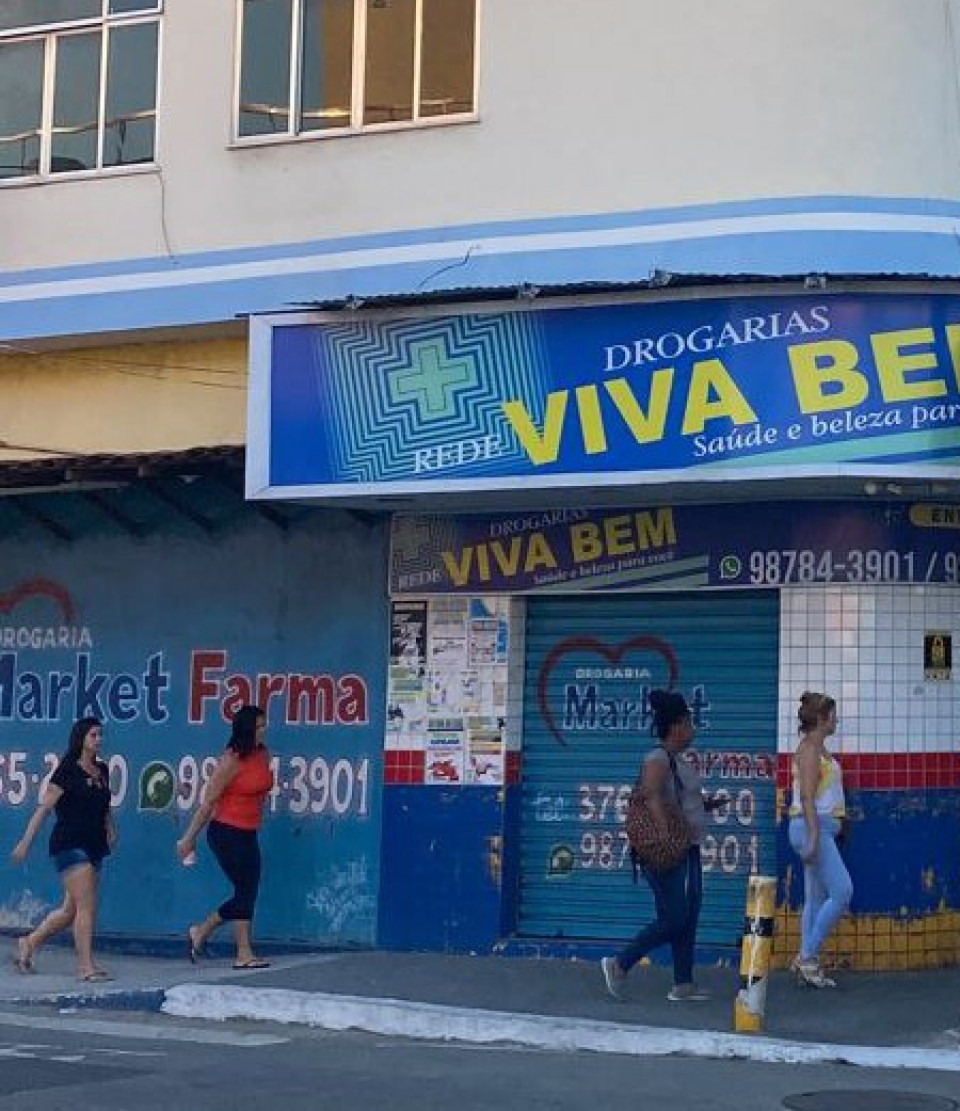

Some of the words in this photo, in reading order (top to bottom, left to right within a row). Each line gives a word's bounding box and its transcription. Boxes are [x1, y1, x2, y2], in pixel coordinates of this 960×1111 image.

[604, 306, 830, 371] DROGARIAS
[503, 359, 758, 465] VIVA
[692, 423, 777, 457] Saúde
[786, 423, 802, 441] e
[811, 408, 901, 437] beleza
[414, 436, 501, 474] REDE
[441, 532, 557, 586] VIVA
[569, 506, 677, 563] BEM
[750, 549, 914, 584] 98784-3901
[0, 626, 92, 648] ROGARIA
[187, 649, 370, 725] Farma
